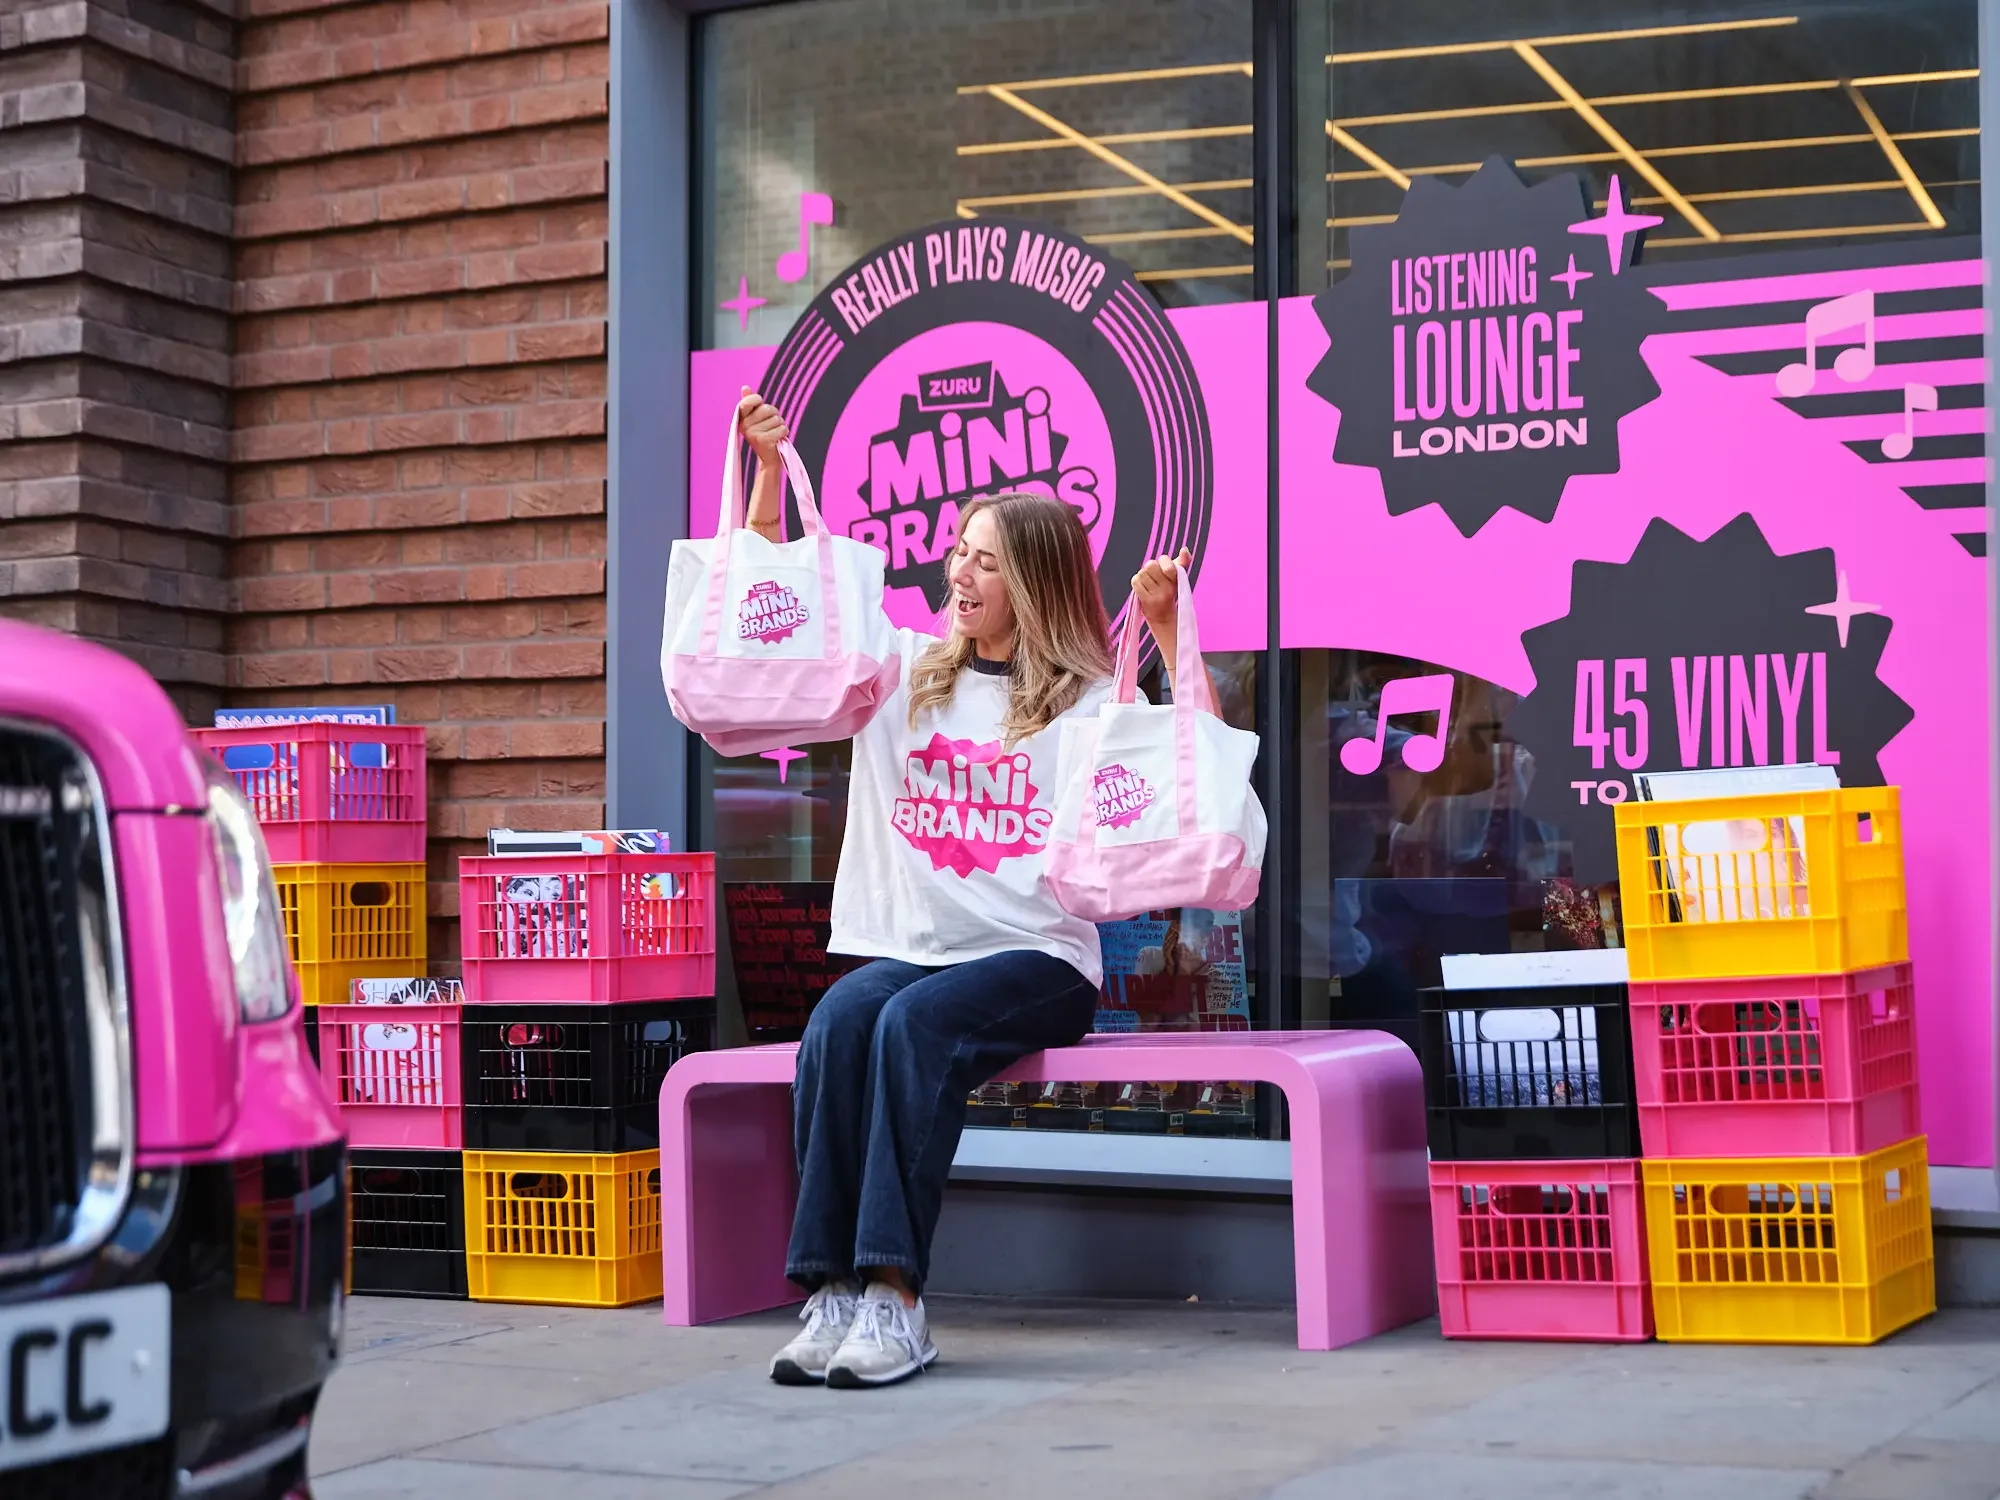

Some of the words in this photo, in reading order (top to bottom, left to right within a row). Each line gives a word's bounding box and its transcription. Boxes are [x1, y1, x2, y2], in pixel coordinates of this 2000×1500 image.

[831, 241, 919, 335] REALLY
[925, 226, 1007, 288] PLAYS
[1009, 230, 1106, 313] MUSIC
[1391, 246, 1537, 316] LISTENING
[928, 377, 982, 397] ZURU
[1393, 309, 1584, 422] LOUNGE
[1393, 418, 1588, 458] LONDON
[850, 468, 1100, 570] BRAS
[738, 605, 809, 638] BRANDS
[1573, 658, 1649, 770] 45
[1670, 652, 1841, 768] VINYL
[1571, 779, 1629, 805] TO
[894, 800, 1053, 847] BRANDS
[358, 979, 441, 1004] SHANIA
[0, 1315, 114, 1441] CC
